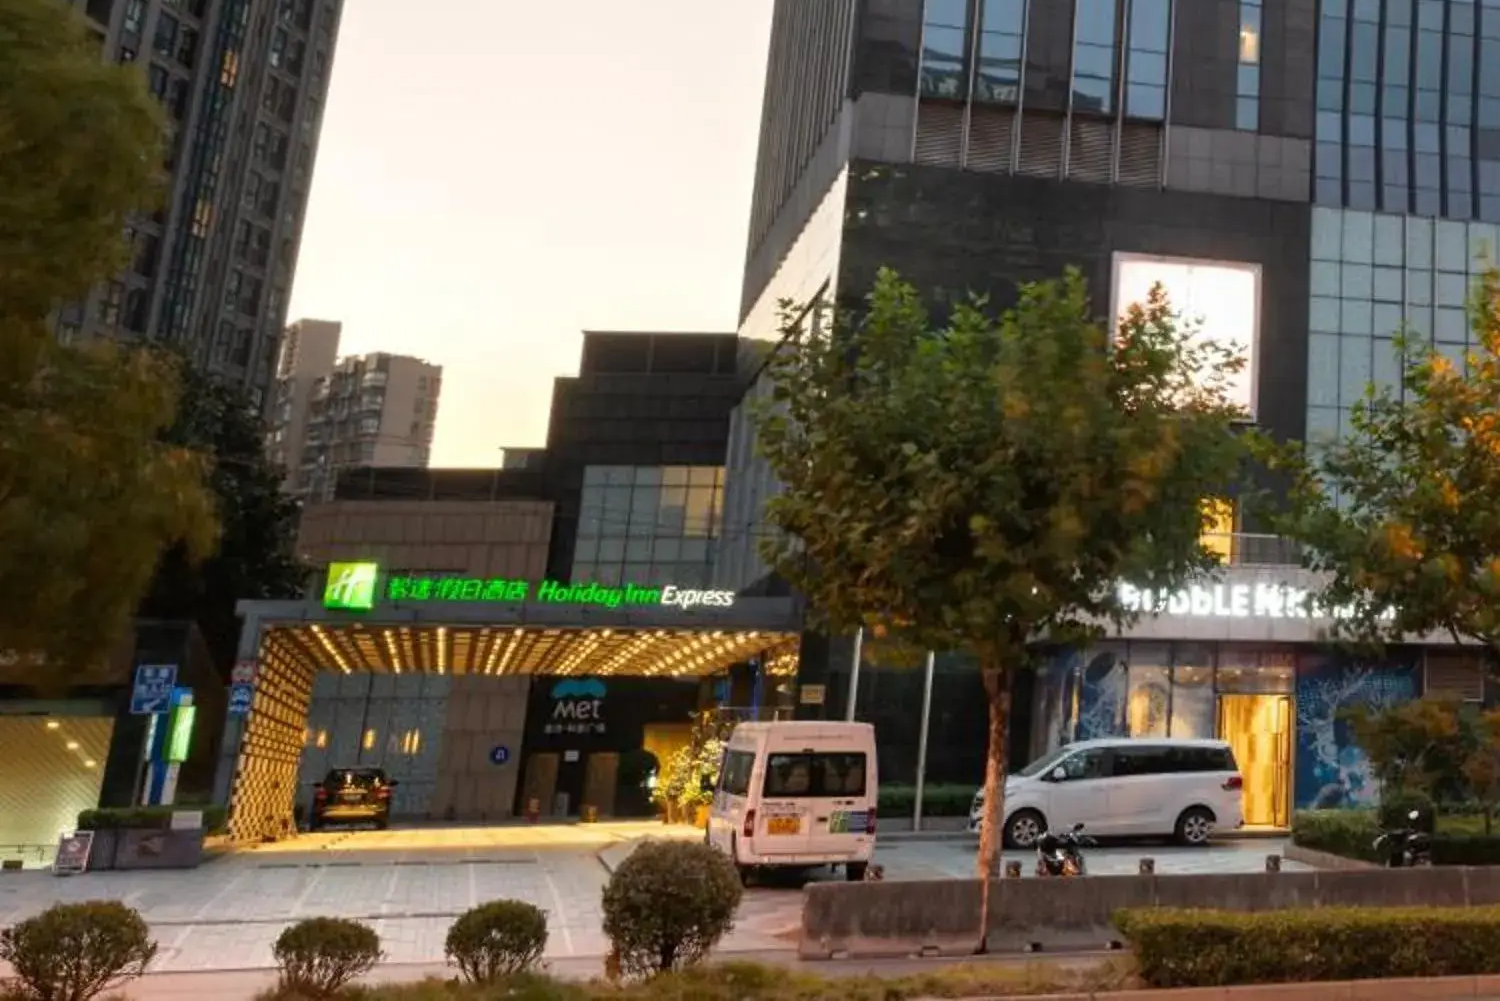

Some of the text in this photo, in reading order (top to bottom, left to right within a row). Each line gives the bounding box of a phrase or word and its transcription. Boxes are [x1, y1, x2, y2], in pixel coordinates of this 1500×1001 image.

[538, 580, 735, 609] Holiday Inn Express
